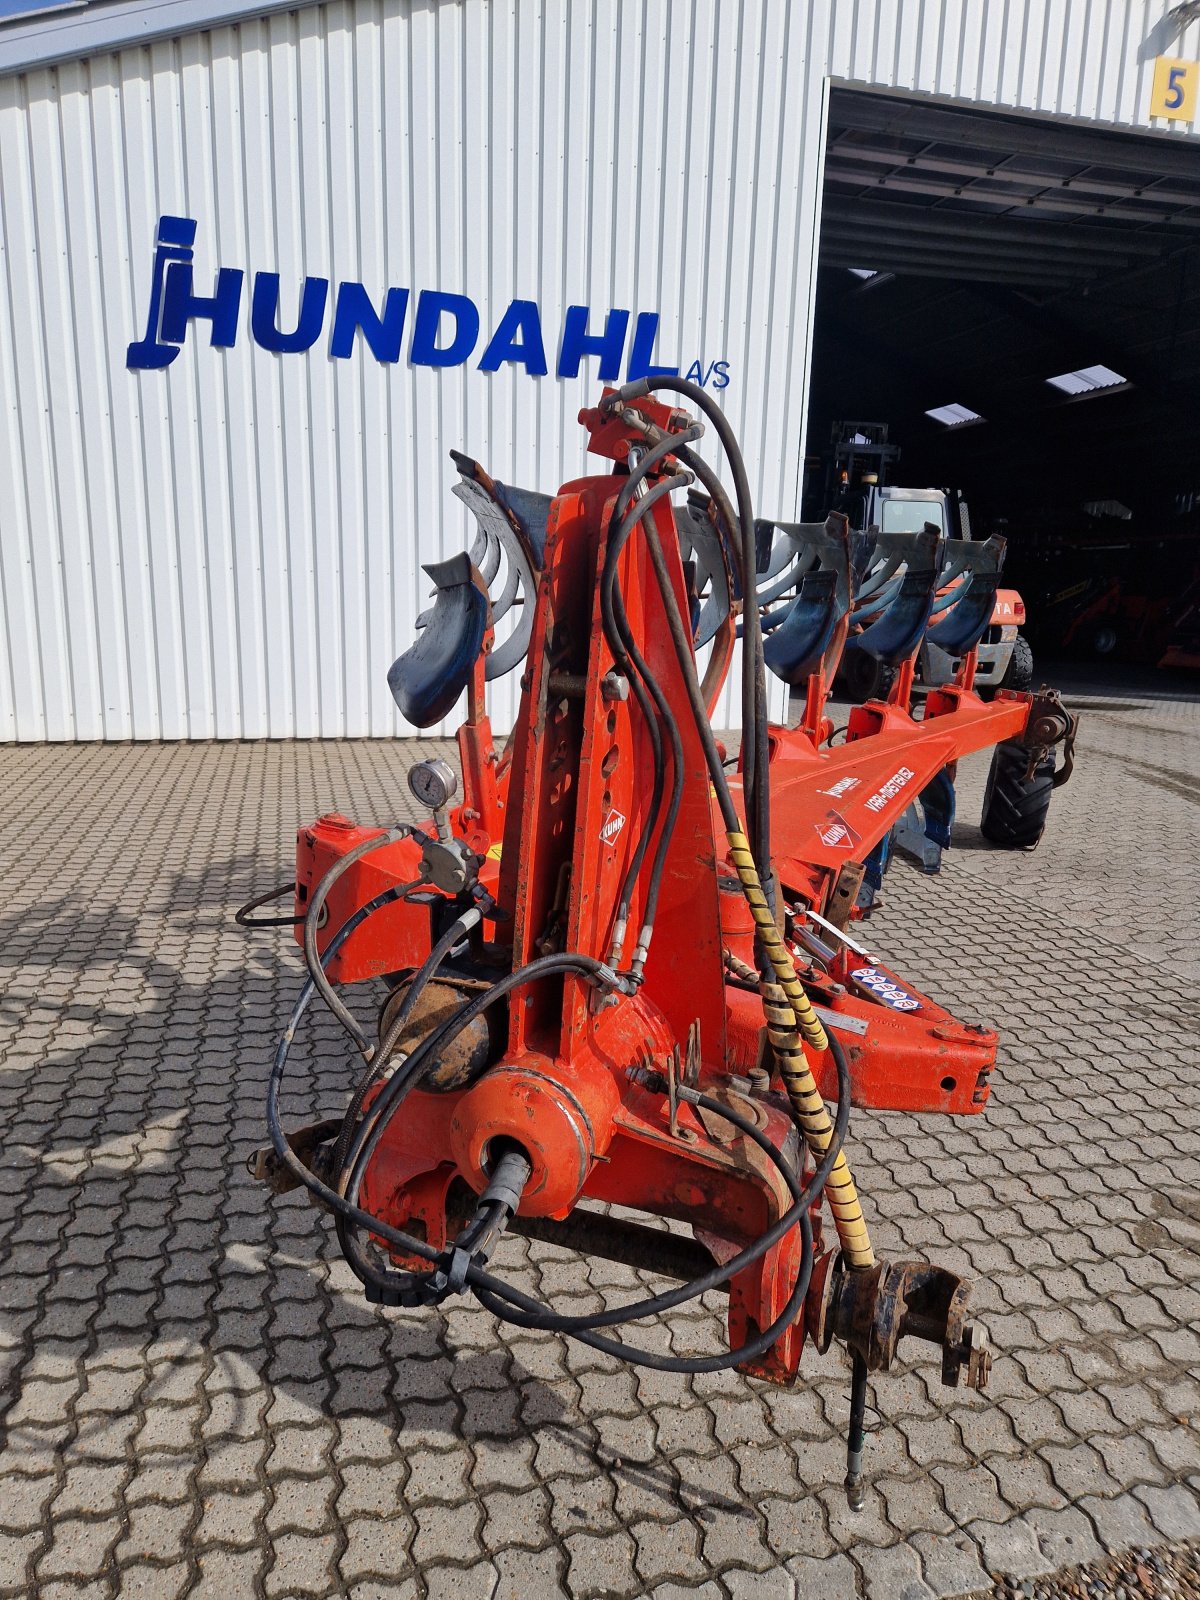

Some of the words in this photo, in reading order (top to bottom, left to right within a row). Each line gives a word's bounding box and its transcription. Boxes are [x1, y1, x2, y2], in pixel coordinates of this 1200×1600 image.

[1165, 67, 1187, 109] 5
[684, 360, 730, 388] A/S
[602, 815, 624, 838] KUHN
[822, 824, 847, 846] KUHN
